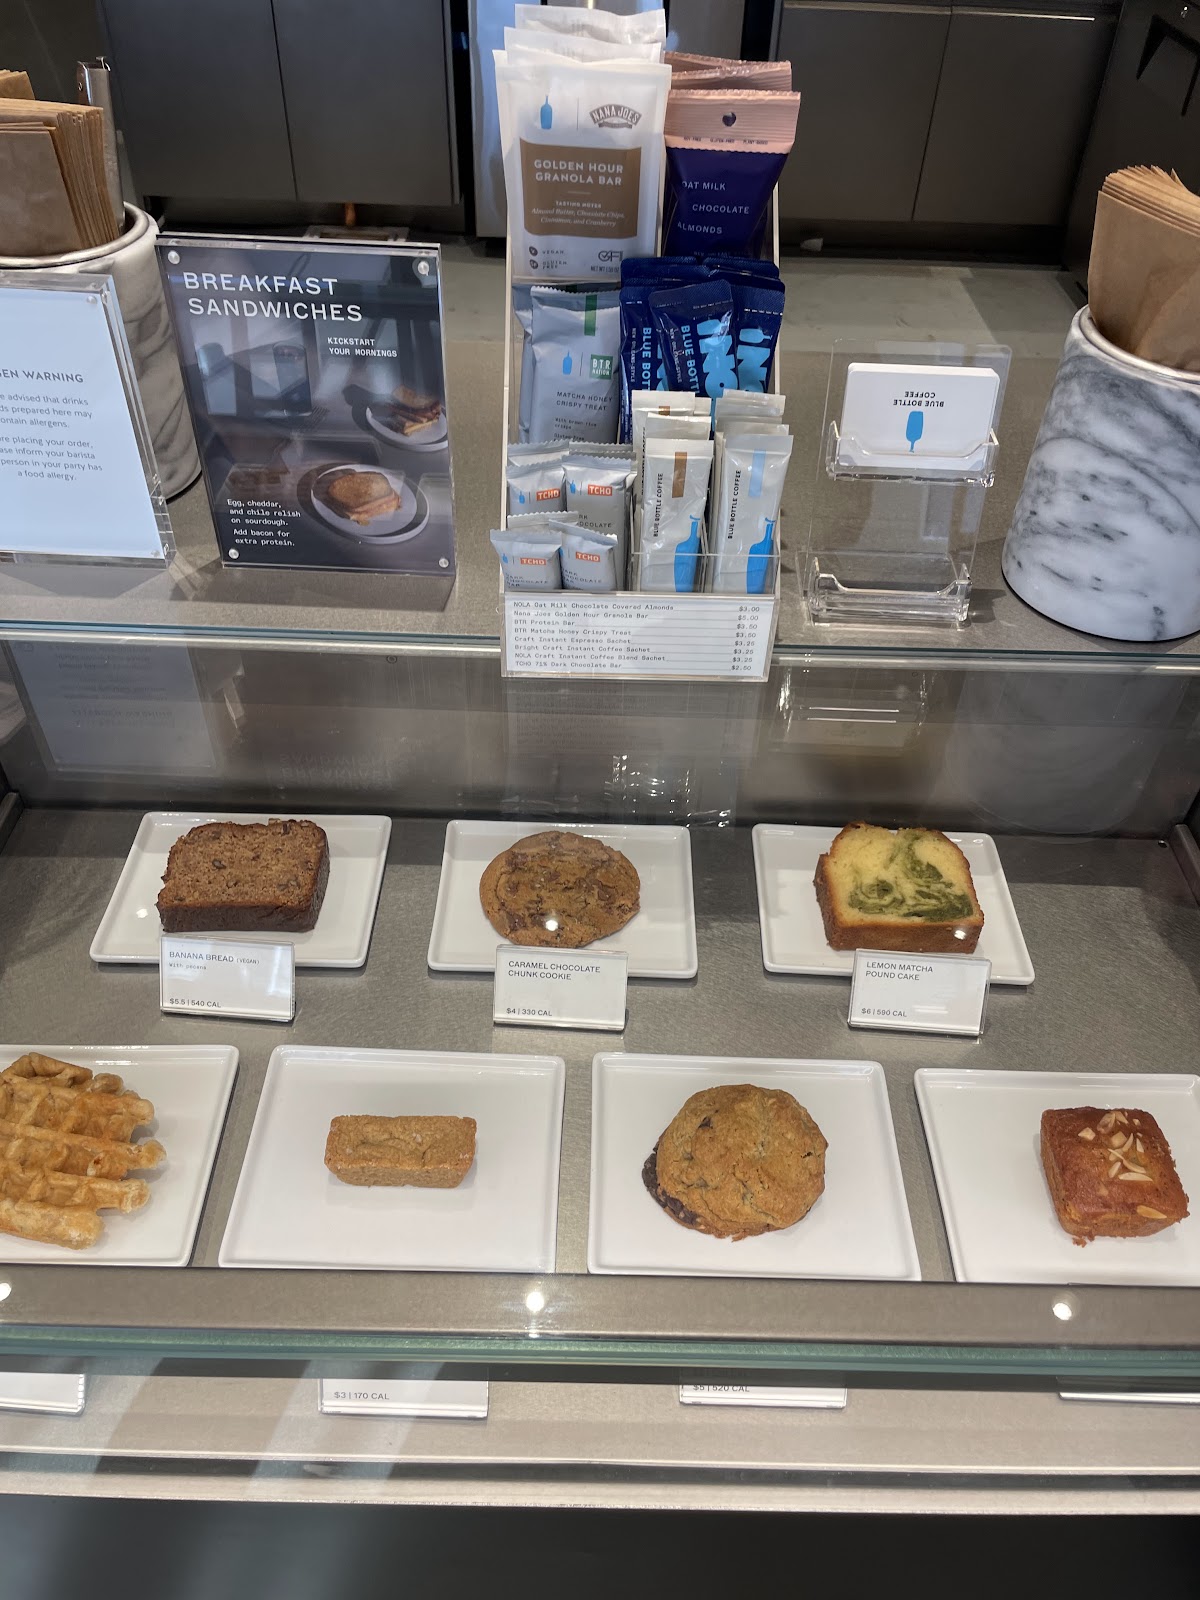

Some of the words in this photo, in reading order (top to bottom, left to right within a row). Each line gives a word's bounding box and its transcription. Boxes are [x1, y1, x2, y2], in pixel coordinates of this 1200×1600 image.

[592, 105, 616, 122] NANA
[618, 107, 638, 123] JOES
[534, 159, 584, 171] GOLDEN
[589, 161, 624, 174] HOUR
[536, 173, 593, 184] GRANOLA
[599, 175, 622, 185] BAR
[703, 182, 725, 190] MILK
[692, 204, 749, 214] CHOCOLATE
[677, 223, 722, 234] ALMONDS
[183, 271, 338, 296] BREAKFAST
[188, 298, 362, 322] SANDWICHES
[327, 337, 375, 346] KICKSTART
[642, 327, 652, 359] BLUE
[681, 325, 694, 356] BLUE
[329, 347, 349, 356] YOUR
[355, 349, 397, 358] MORNINGS
[23, 370, 83, 383] WARNING
[8, 394, 40, 402] advised
[43, 395, 59, 403] that
[62, 397, 88, 405] drinks
[557, 391, 586, 400] MATCHA
[556, 400, 582, 408] CRISPY
[585, 403, 607, 411] TREAT
[12, 407, 50, 415] prepared
[52, 408, 71, 416] here
[74, 411, 92, 419] may
[30, 418, 69, 428] allergens.
[12, 436, 43, 446] placing
[68, 440, 93, 449] order,
[15, 448, 43, 456] inform
[67, 450, 95, 459] barista
[63, 463, 85, 471] party
[88, 463, 102, 471] has
[24, 470, 44, 478] food
[47, 472, 77, 481] allergy.
[538, 490, 560, 500] TCHO
[589, 485, 612, 495] TCHO
[730, 497, 738, 522] BOTTLE
[734, 470, 742, 496] COFFEE
[227, 499, 244, 507] Egg,
[247, 500, 281, 508] cheddar,
[245, 518, 288, 526] sourdough.
[577, 552, 599, 561] TCHO
[169, 951, 203, 960] BANANA
[206, 953, 234, 962] BREAD
[509, 960, 548, 969] CARAMEL
[550, 964, 600, 973] CHOCOLATE
[867, 962, 897, 970] LEMON
[899, 964, 933, 973] MATCHA
[509, 970, 538, 978] CHUNK
[540, 972, 571, 980] COOKIE
[866, 971, 896, 979] POUND
[897, 973, 920, 981] CAKE
[861, 1007, 871, 1015] $6
[334, 1391, 346, 1399] $3
[354, 1392, 369, 1400] 170
